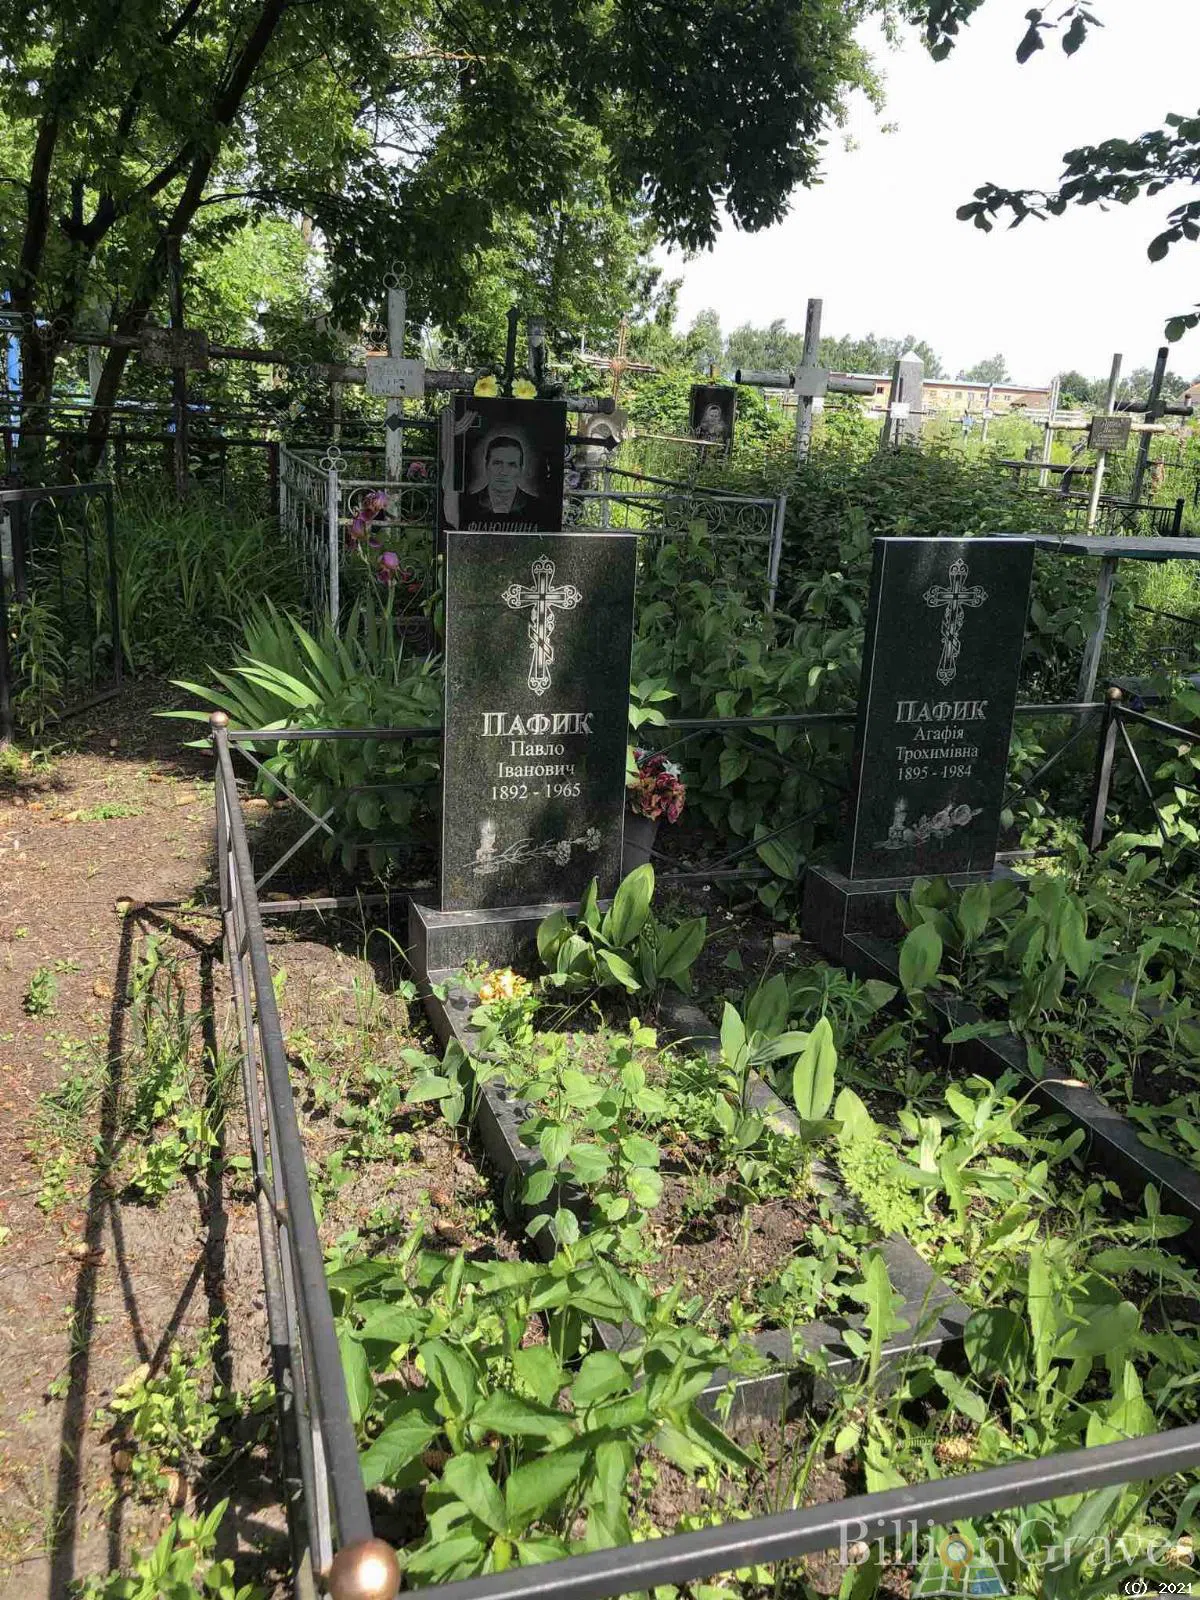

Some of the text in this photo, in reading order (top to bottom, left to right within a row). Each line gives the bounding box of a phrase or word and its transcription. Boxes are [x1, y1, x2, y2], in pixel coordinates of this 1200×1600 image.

[895, 699, 988, 723] ПАФИК
[481, 712, 594, 737] ПАФИК
[913, 724, 964, 743] Агафія
[509, 740, 565, 757] Павло
[895, 743, 978, 764] Трохимівна
[499, 761, 575, 778] Іванович
[898, 766, 928, 781] 1895
[941, 764, 972, 779] 1984
[492, 784, 528, 800] 1892
[546, 782, 581, 798] 1965
